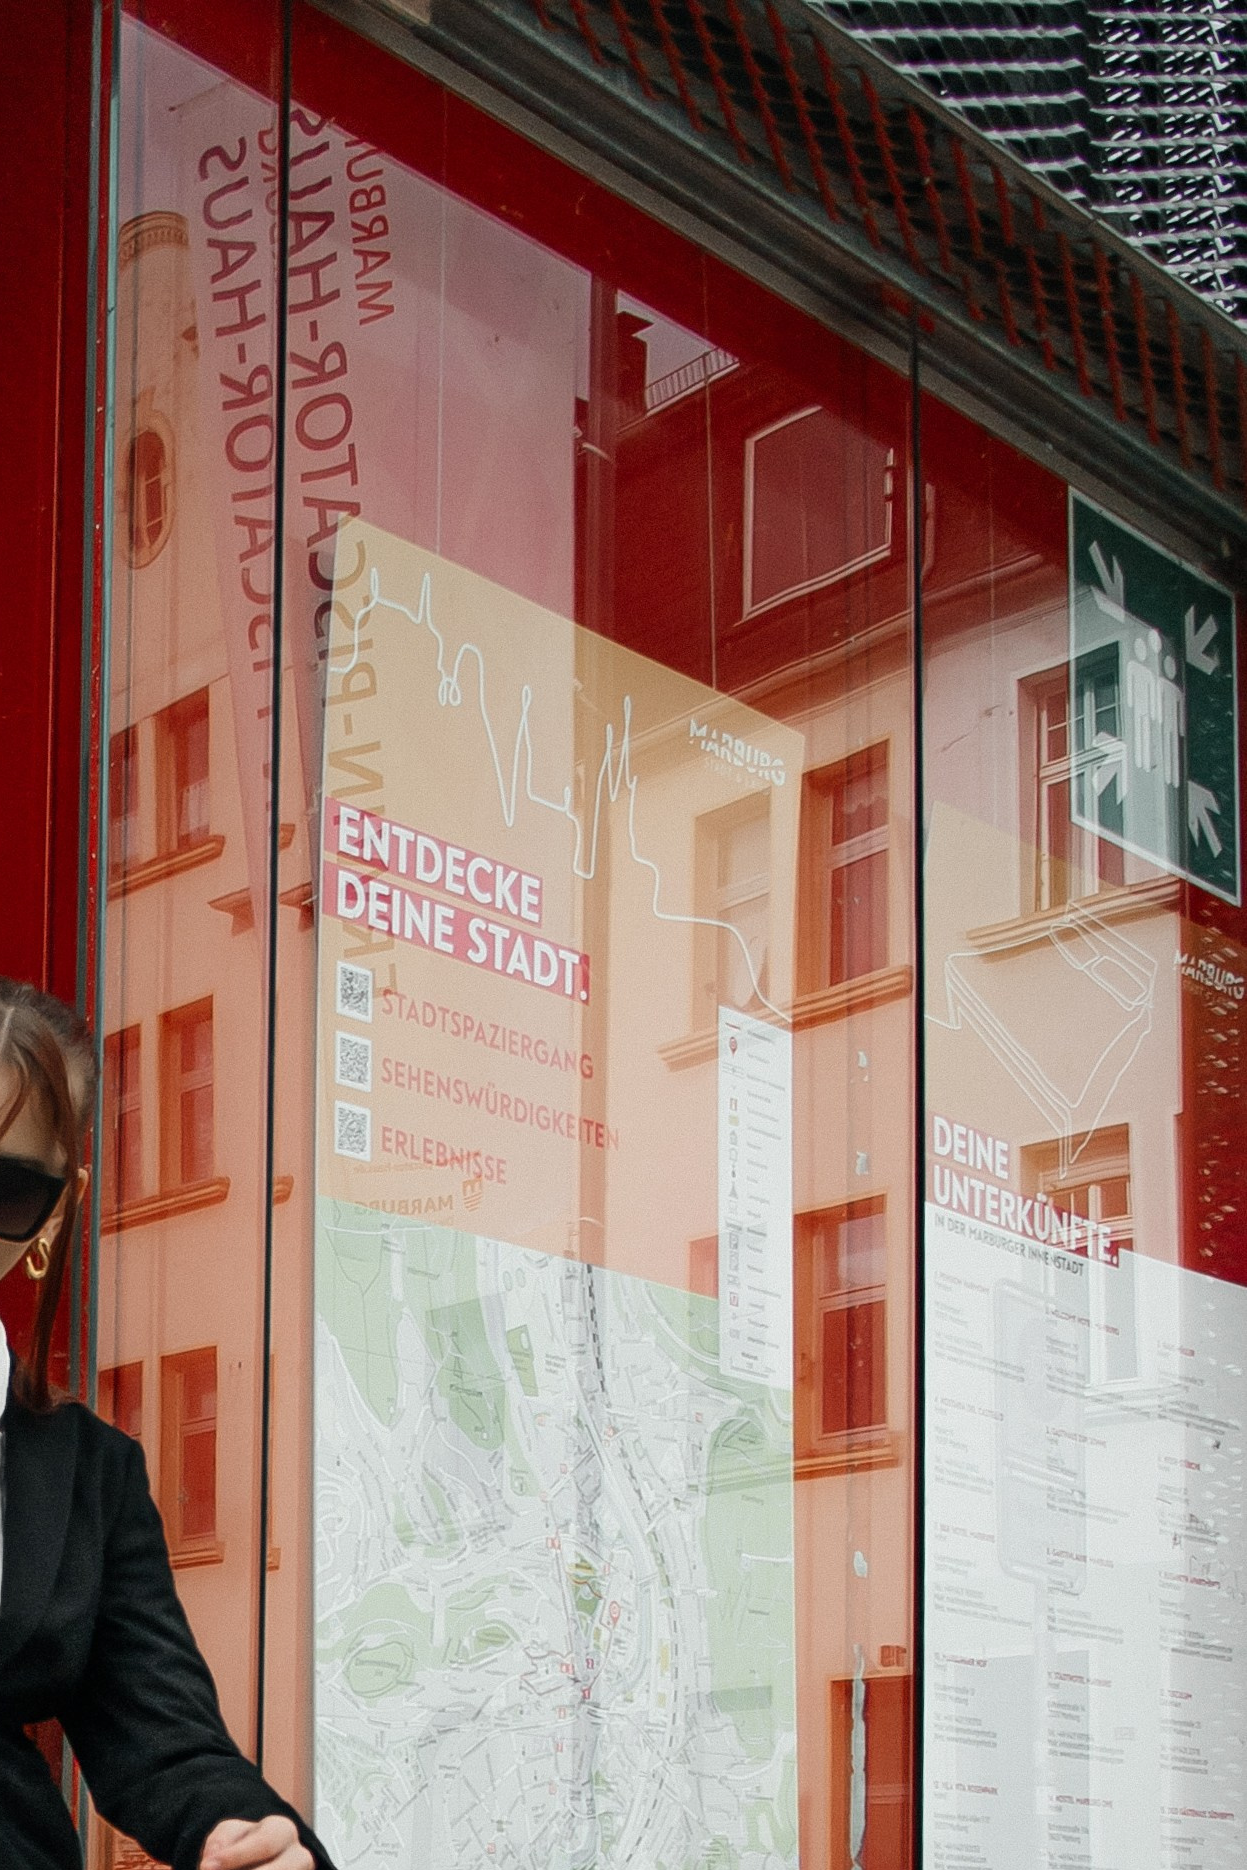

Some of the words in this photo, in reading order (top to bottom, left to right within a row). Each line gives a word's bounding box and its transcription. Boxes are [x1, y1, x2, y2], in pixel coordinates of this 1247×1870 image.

[338, 804, 541, 923] ENTDECKE
[336, 869, 455, 954] DEINE
[467, 918, 590, 1002] STADT.
[380, 987, 594, 1079] STADTSPAZIERGANG
[380, 1056, 620, 1151] SEHENSWÜRDIGKEITEN
[933, 1115, 1009, 1180] DEINE
[380, 1125, 508, 1186] ERLEBNISSE
[933, 1164, 1120, 1265] UNTERKÜNFTE.
[947, 1218, 966, 1239] DER
[968, 1223, 1027, 1258] MARBURGER
